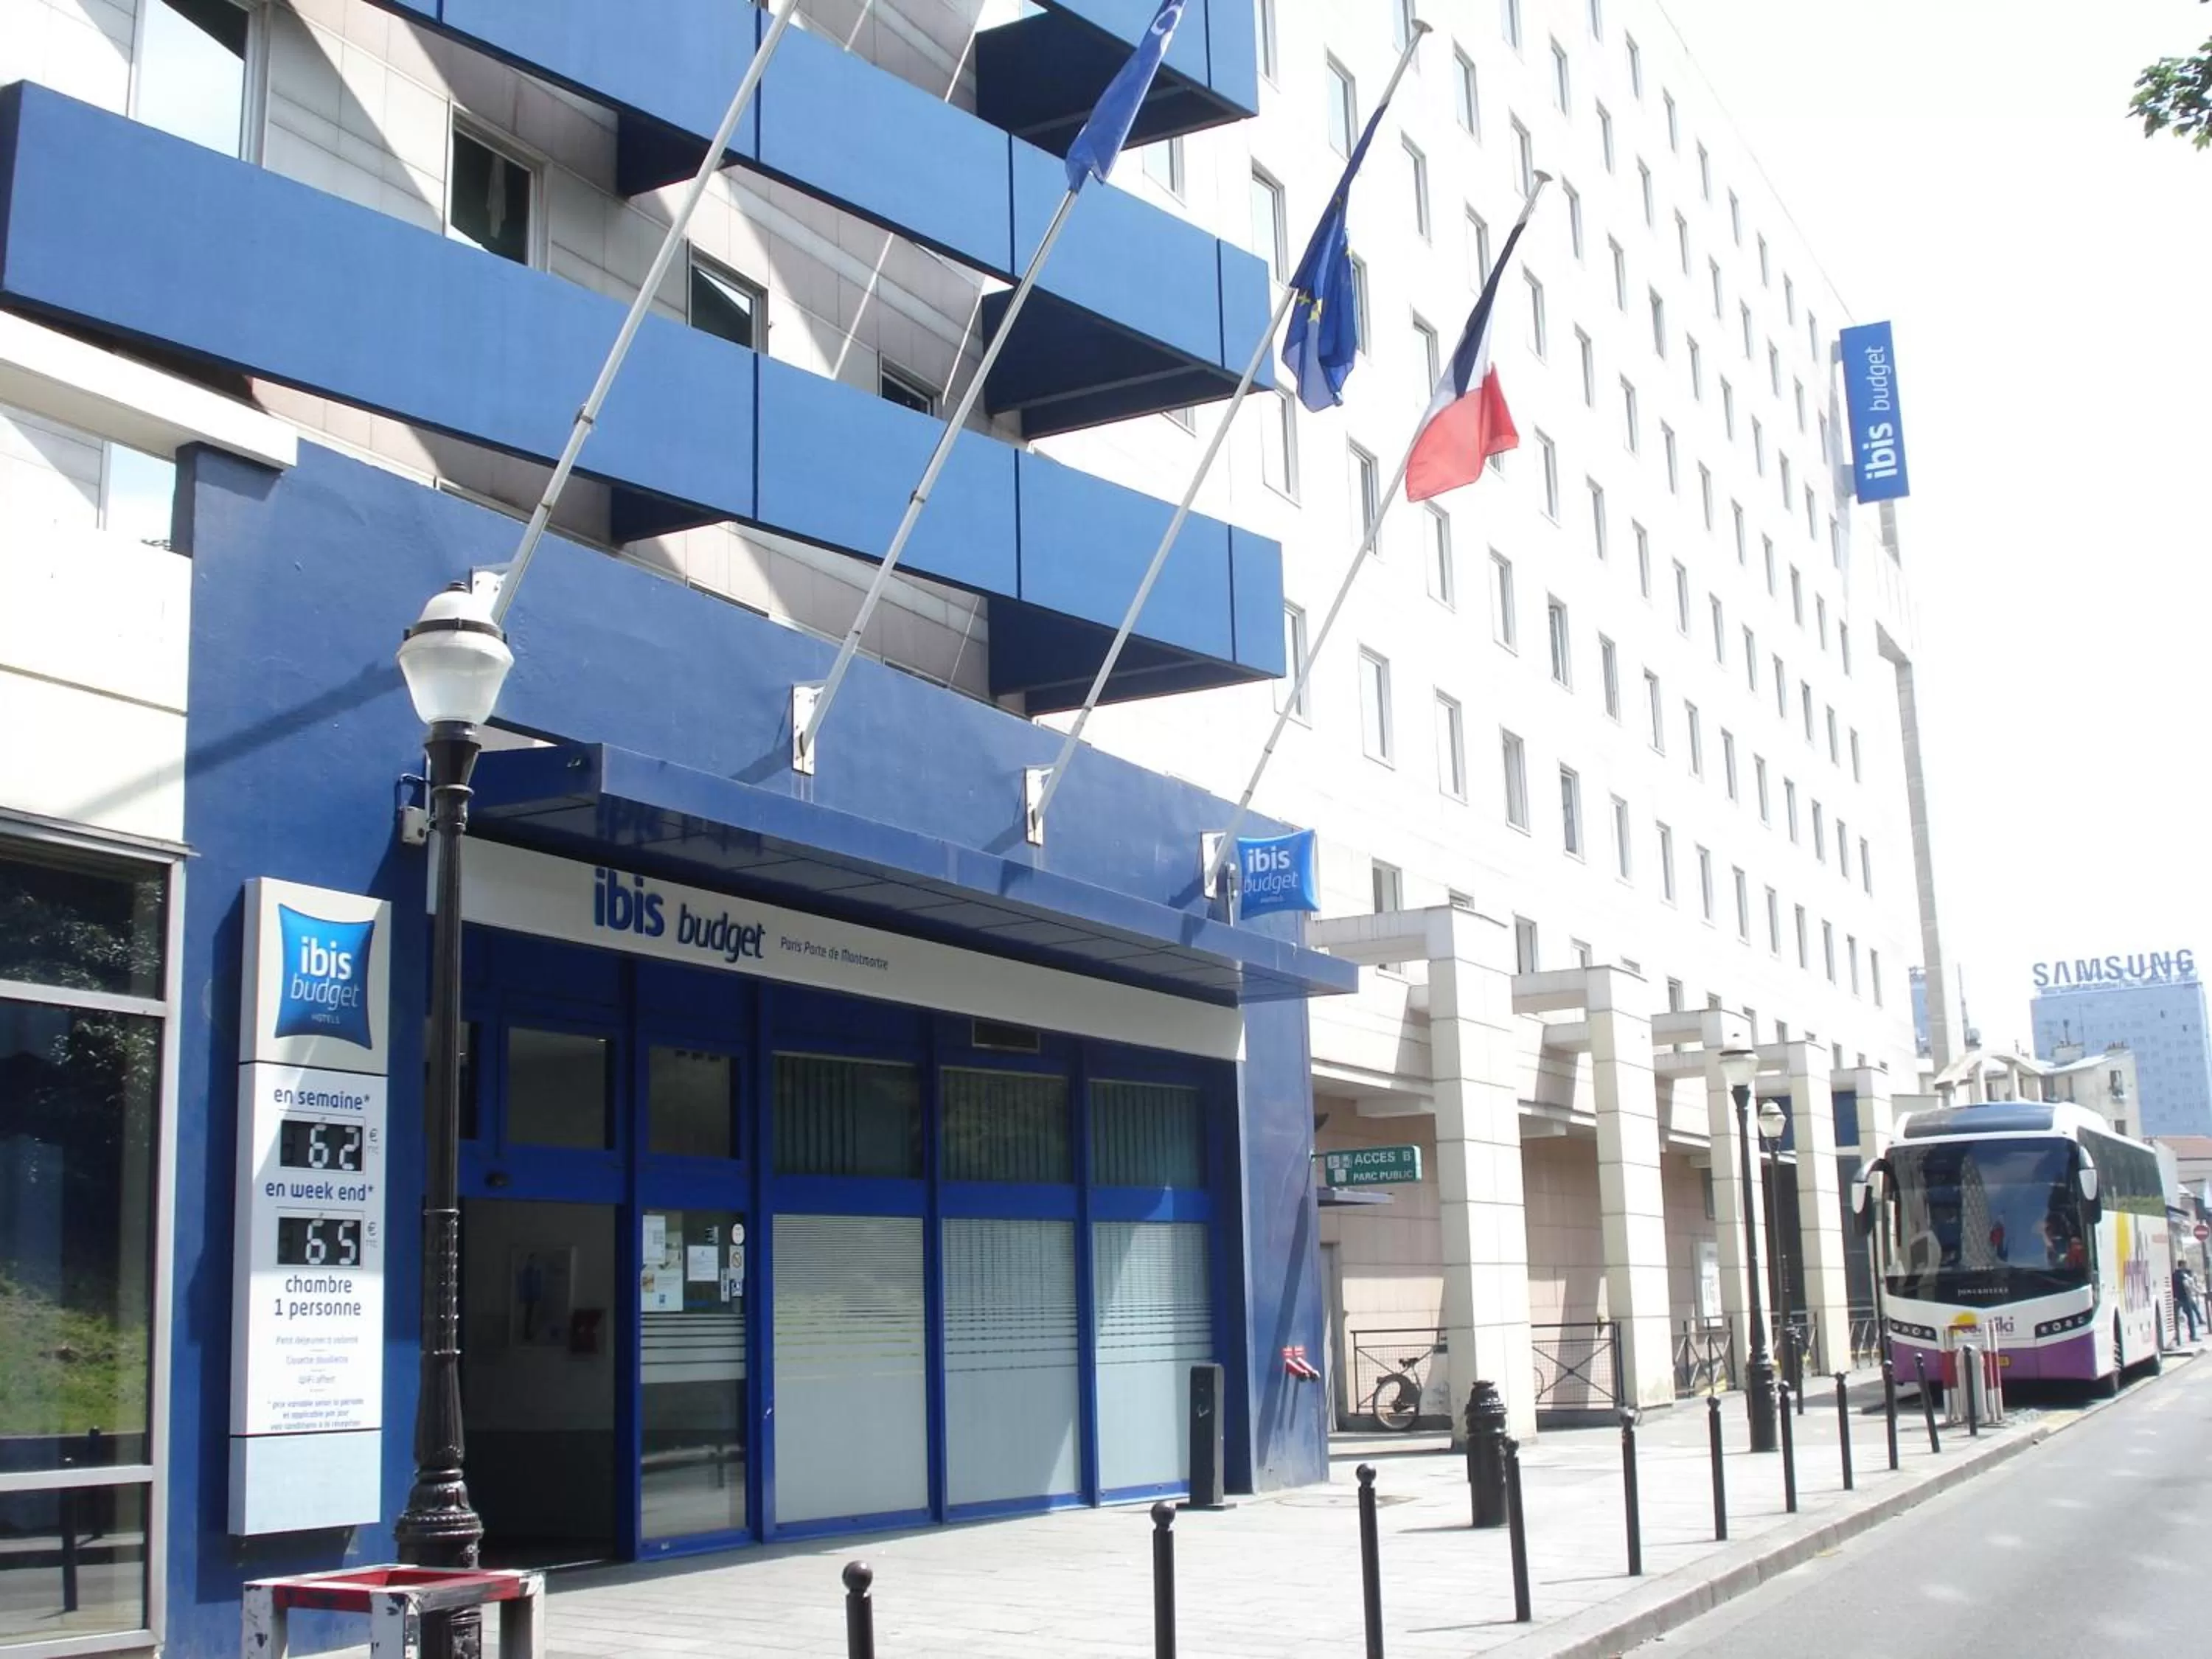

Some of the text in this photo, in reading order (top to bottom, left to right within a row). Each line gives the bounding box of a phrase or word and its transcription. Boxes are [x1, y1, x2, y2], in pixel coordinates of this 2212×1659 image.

[1863, 345, 1898, 480] ibis budget
[1248, 846, 1290, 873] ibis
[1244, 871, 1298, 894] budget
[594, 868, 665, 938] ibis
[677, 902, 765, 963] budget
[781, 936, 802, 952] Paris
[828, 947, 839, 960] de
[300, 936, 352, 980] ibis
[2032, 949, 2194, 986] SAMSUNG
[290, 973, 360, 1010] budget
[274, 1088, 293, 1104] en
[308, 1123, 360, 1170] 62
[265, 1181, 285, 1197] en
[291, 1181, 333, 1200] week
[1354, 1169, 1413, 1182] PARC PUBLIC
[305, 1219, 356, 1265] 65
[285, 1275, 352, 1293] chambre
[274, 1298, 361, 1320] 1 personne
